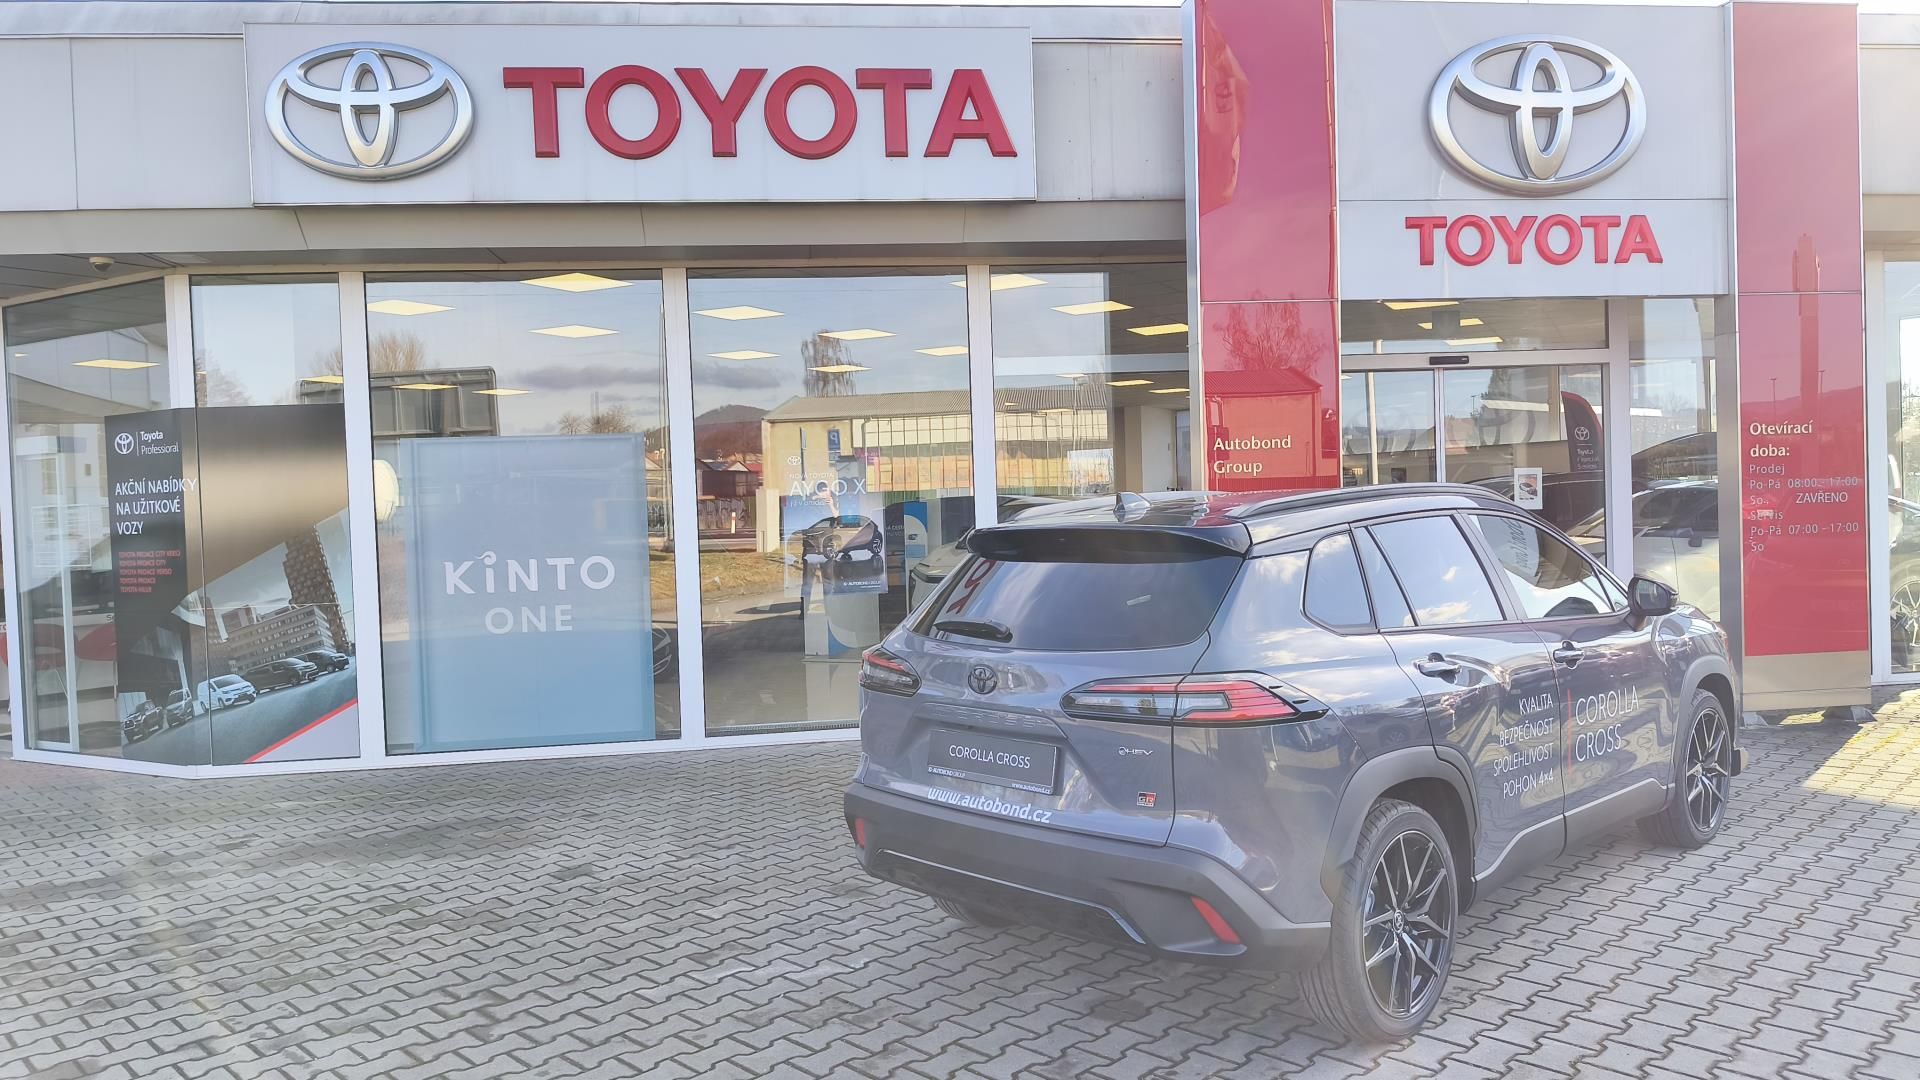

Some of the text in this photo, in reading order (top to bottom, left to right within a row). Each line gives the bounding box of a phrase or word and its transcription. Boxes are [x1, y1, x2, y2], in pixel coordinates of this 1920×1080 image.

[503, 65, 1017, 159] TOYOTA
[1405, 214, 1663, 266] TOYOTA
[140, 430, 163, 442] Toyota
[1750, 420, 1813, 435] Otevírací
[141, 442, 179, 454] Professional
[1213, 435, 1291, 450] Autobond
[1751, 444, 1790, 457] doba:
[1213, 460, 1263, 476] Group
[1749, 464, 1785, 475] Prodej
[115, 476, 197, 495] AKČNÍ NABÍDKY
[854, 479, 866, 494] X
[116, 496, 181, 515] NA UŽITKOVÉ
[1796, 491, 1848, 504] ZAVŘENO
[116, 521, 143, 535] VOZY
[1789, 524, 1818, 535] 07:00
[1830, 523, 1859, 533] 17:00
[485, 604, 573, 634] ONE
[1519, 693, 1553, 715] KVALITA
[1575, 685, 1639, 725] COROLLA
[1500, 718, 1554, 748] BEZPEČNOST
[1575, 724, 1622, 761] CROSS
[949, 745, 1031, 769] COROLLA CROSS
[1493, 743, 1554, 777] SPOLEHLIVOST
[1503, 768, 1554, 799] POHON 4x4
[927, 787, 1052, 823] www.autobond.cz
